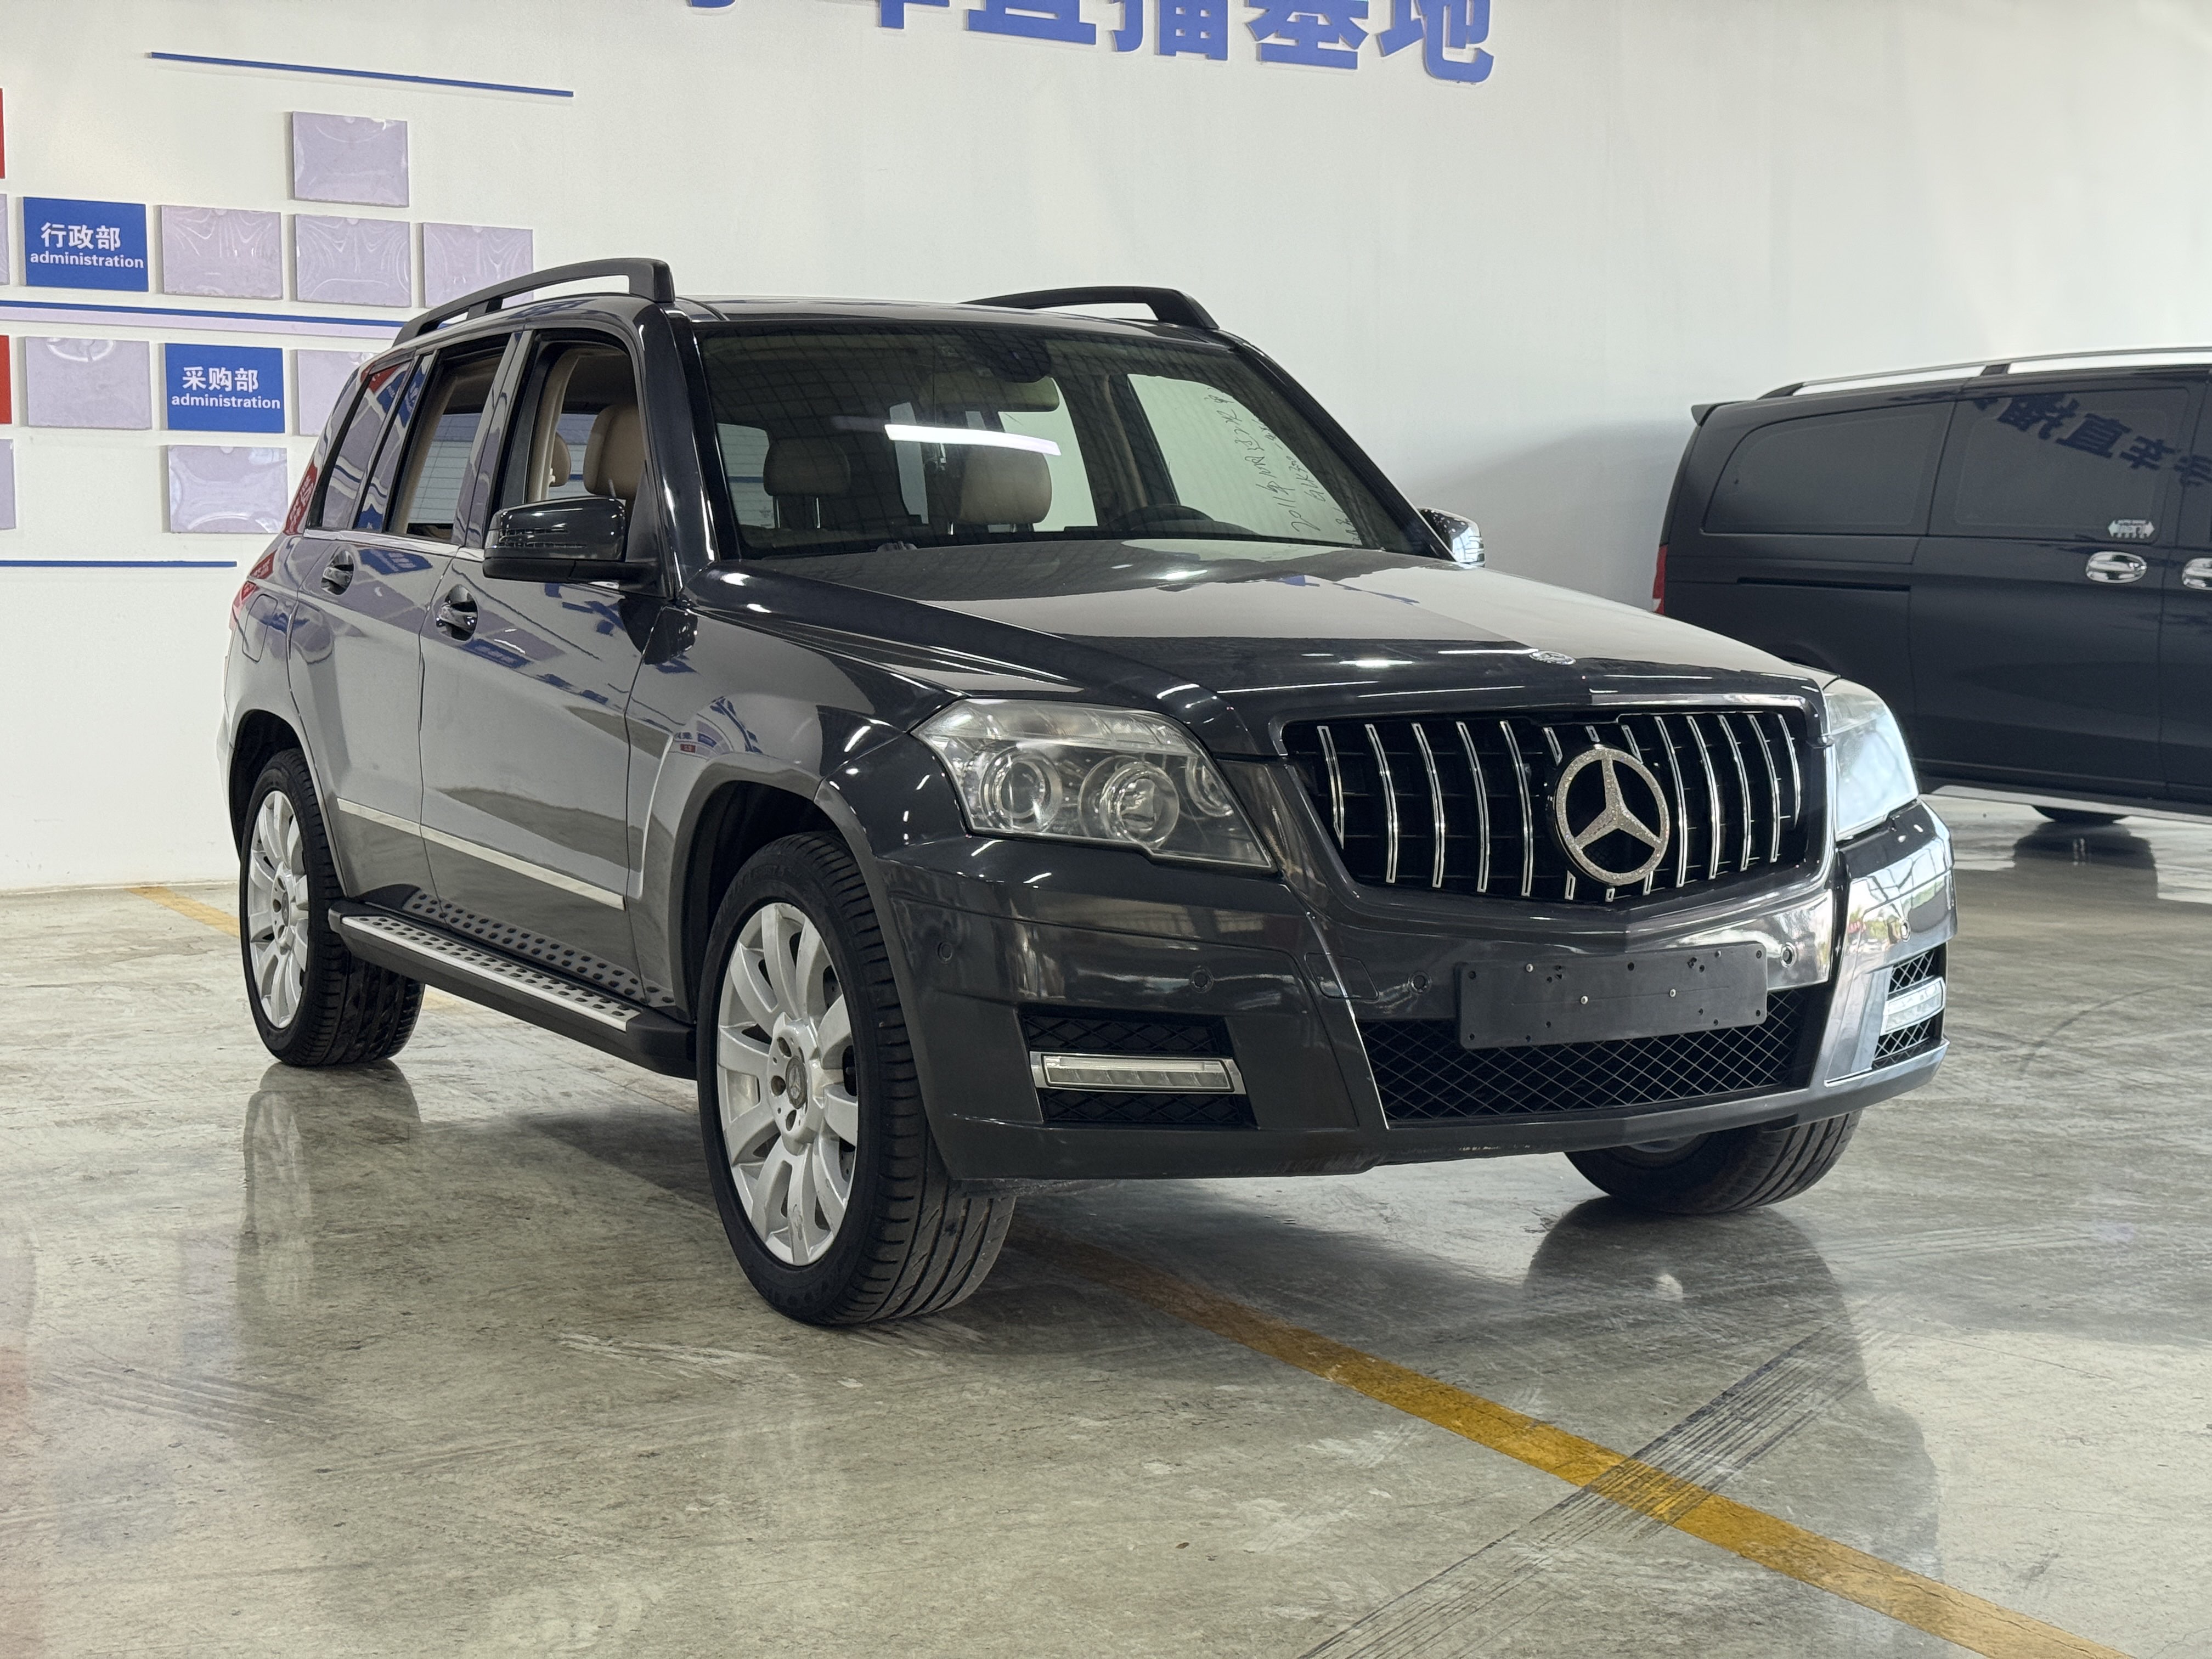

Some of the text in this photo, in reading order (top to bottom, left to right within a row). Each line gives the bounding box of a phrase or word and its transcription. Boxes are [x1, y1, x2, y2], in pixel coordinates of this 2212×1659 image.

[41, 222, 121, 251] 行政部
[30, 250, 144, 269] administration
[182, 366, 259, 393] 采购部
[171, 393, 281, 409] administration
